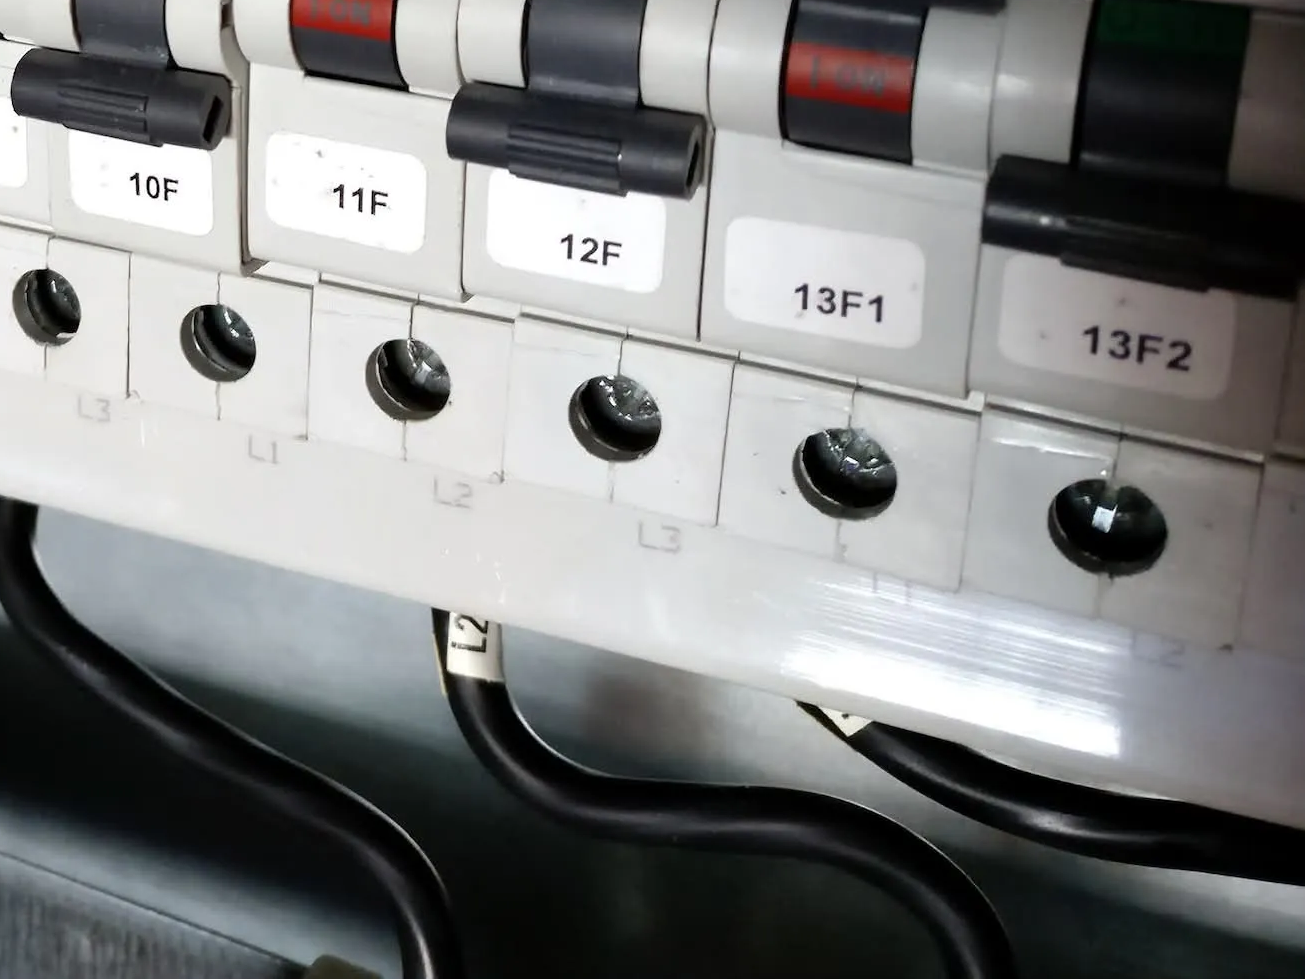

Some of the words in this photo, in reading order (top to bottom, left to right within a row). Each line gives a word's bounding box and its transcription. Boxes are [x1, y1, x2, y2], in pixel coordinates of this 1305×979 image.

[129, 172, 179, 202] 10F
[332, 183, 389, 216] 11F
[560, 233, 623, 267] 12F
[794, 283, 885, 323] 13F1
[1082, 325, 1193, 372] 13F2
[78, 396, 111, 422] L3
[248, 433, 279, 465] L1
[433, 478, 473, 509] L2
[638, 521, 681, 553] L3
[451, 613, 489, 653] L2
